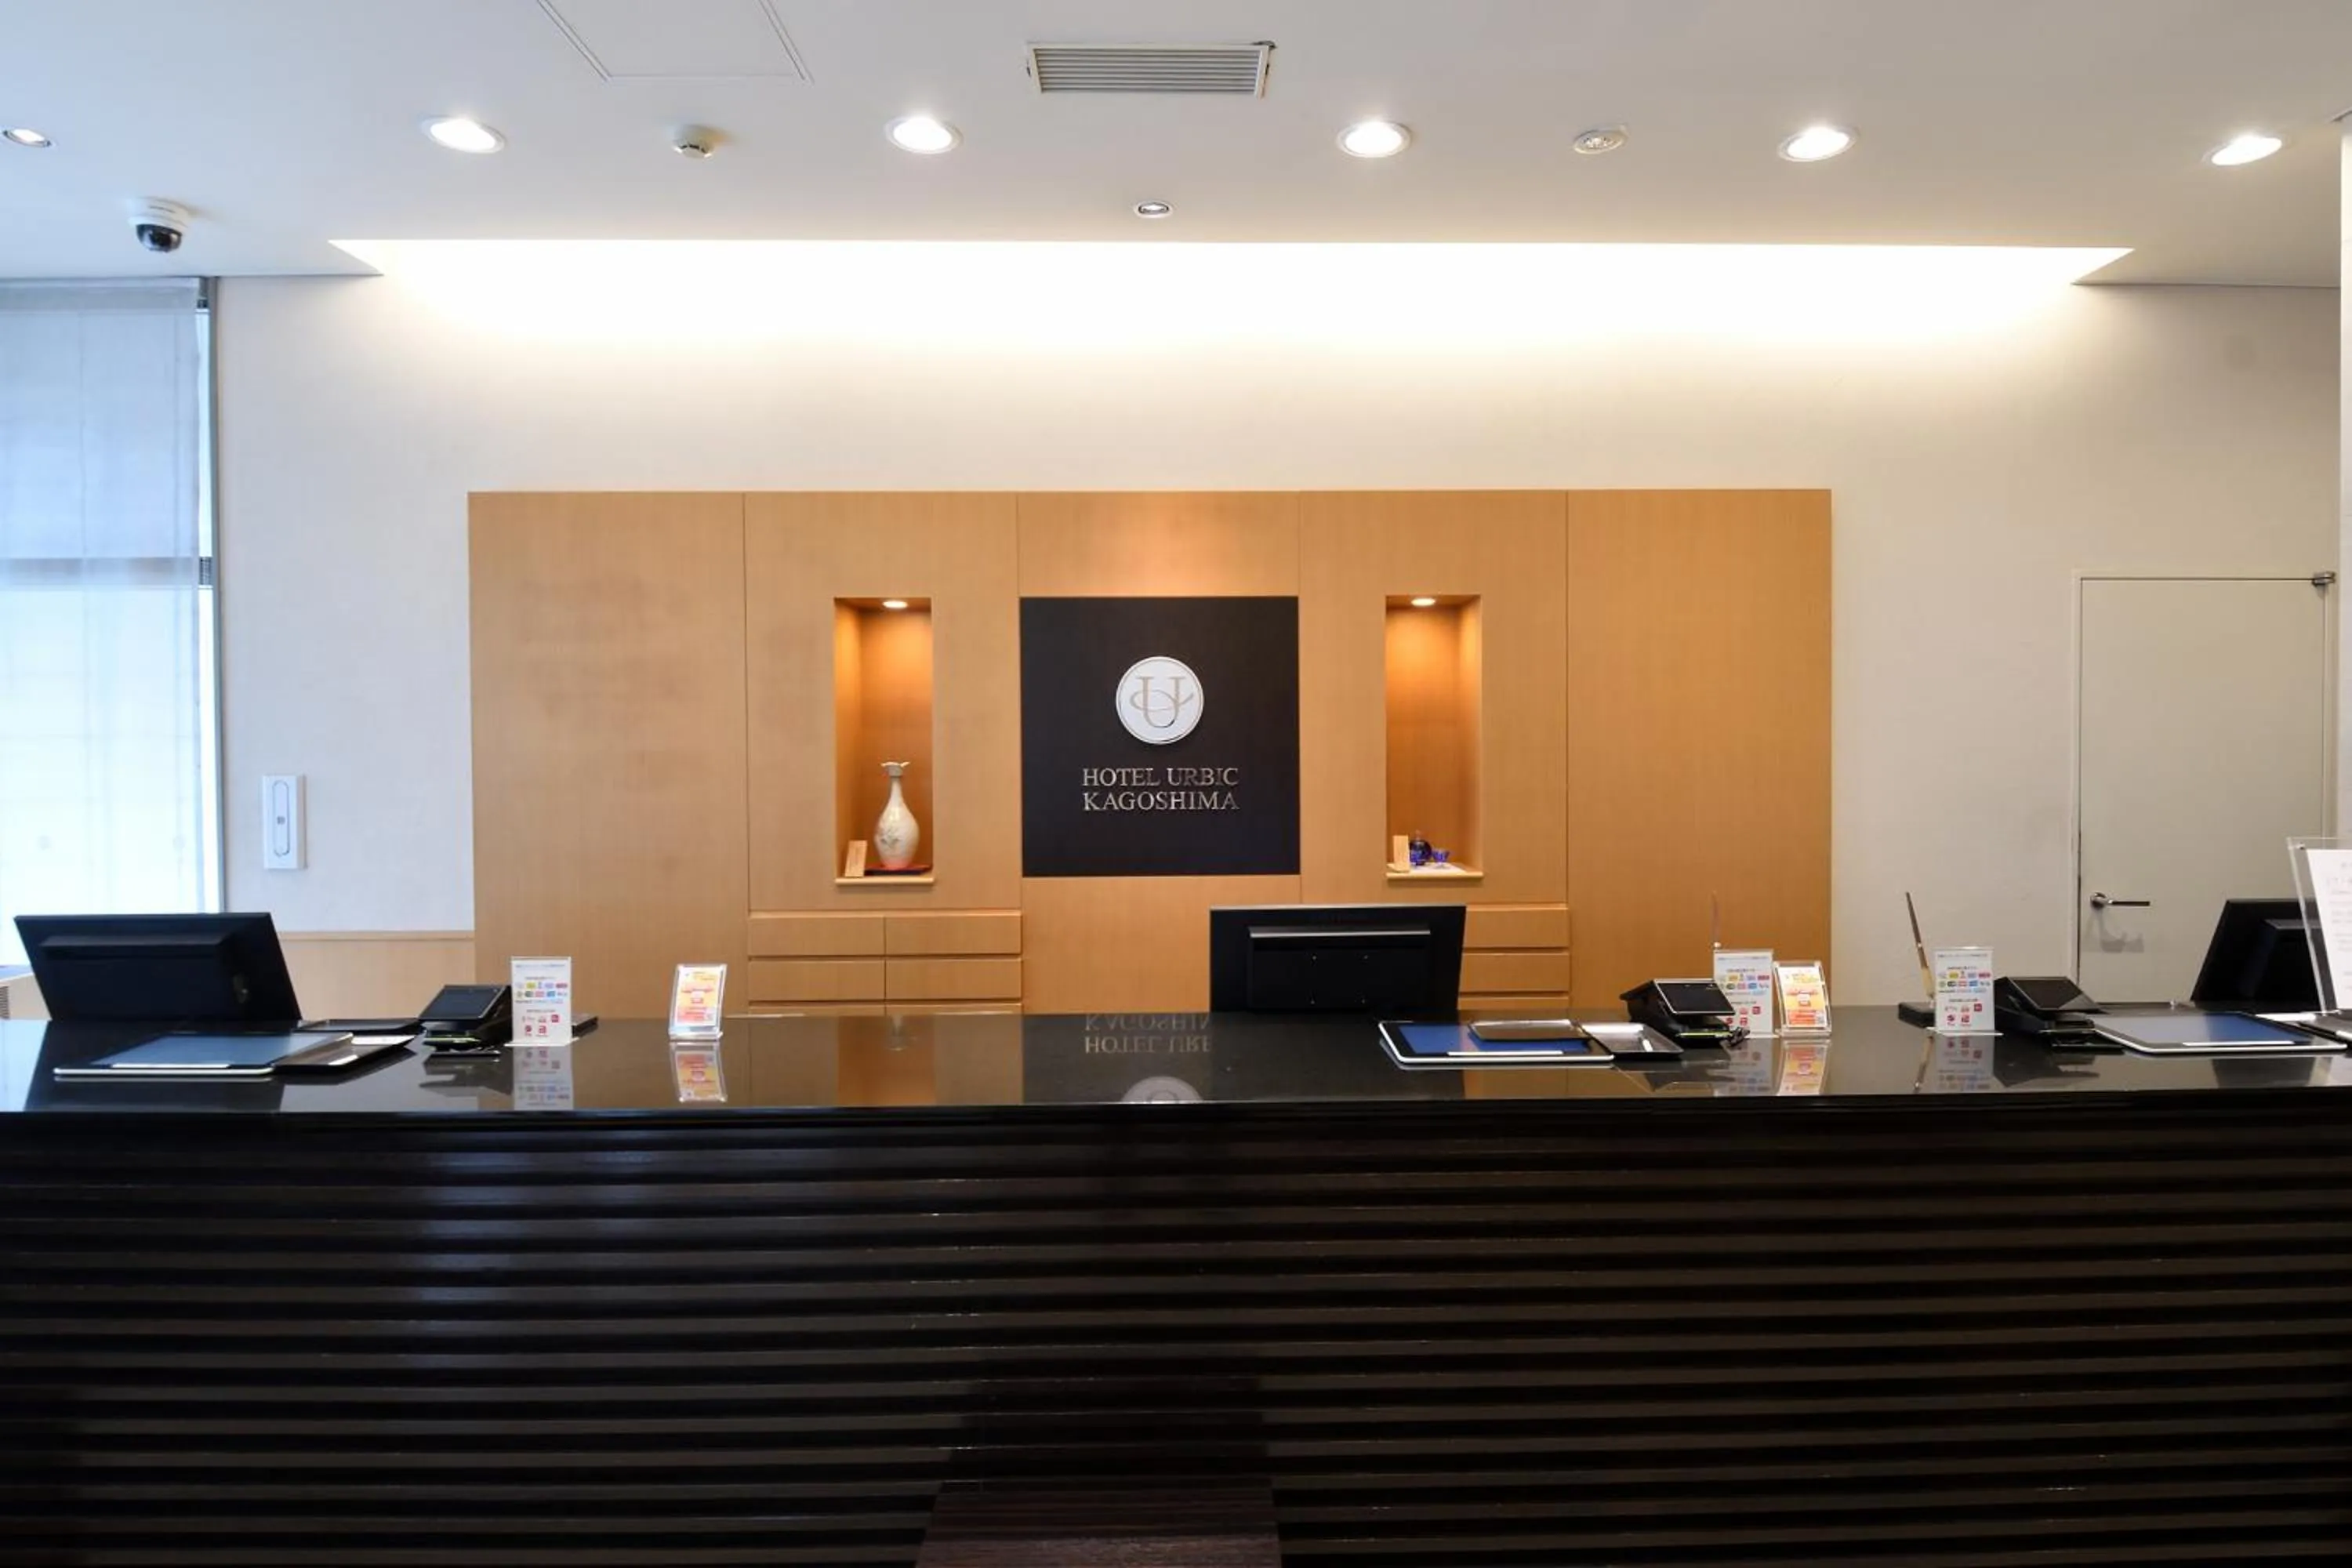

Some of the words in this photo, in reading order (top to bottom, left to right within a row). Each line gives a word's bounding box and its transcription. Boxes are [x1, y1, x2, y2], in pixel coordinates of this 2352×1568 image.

[1083, 768, 1161, 786] HOTEL
[1167, 768, 1239, 786] URBIC
[1083, 791, 1240, 811] KAGOSHIMA
